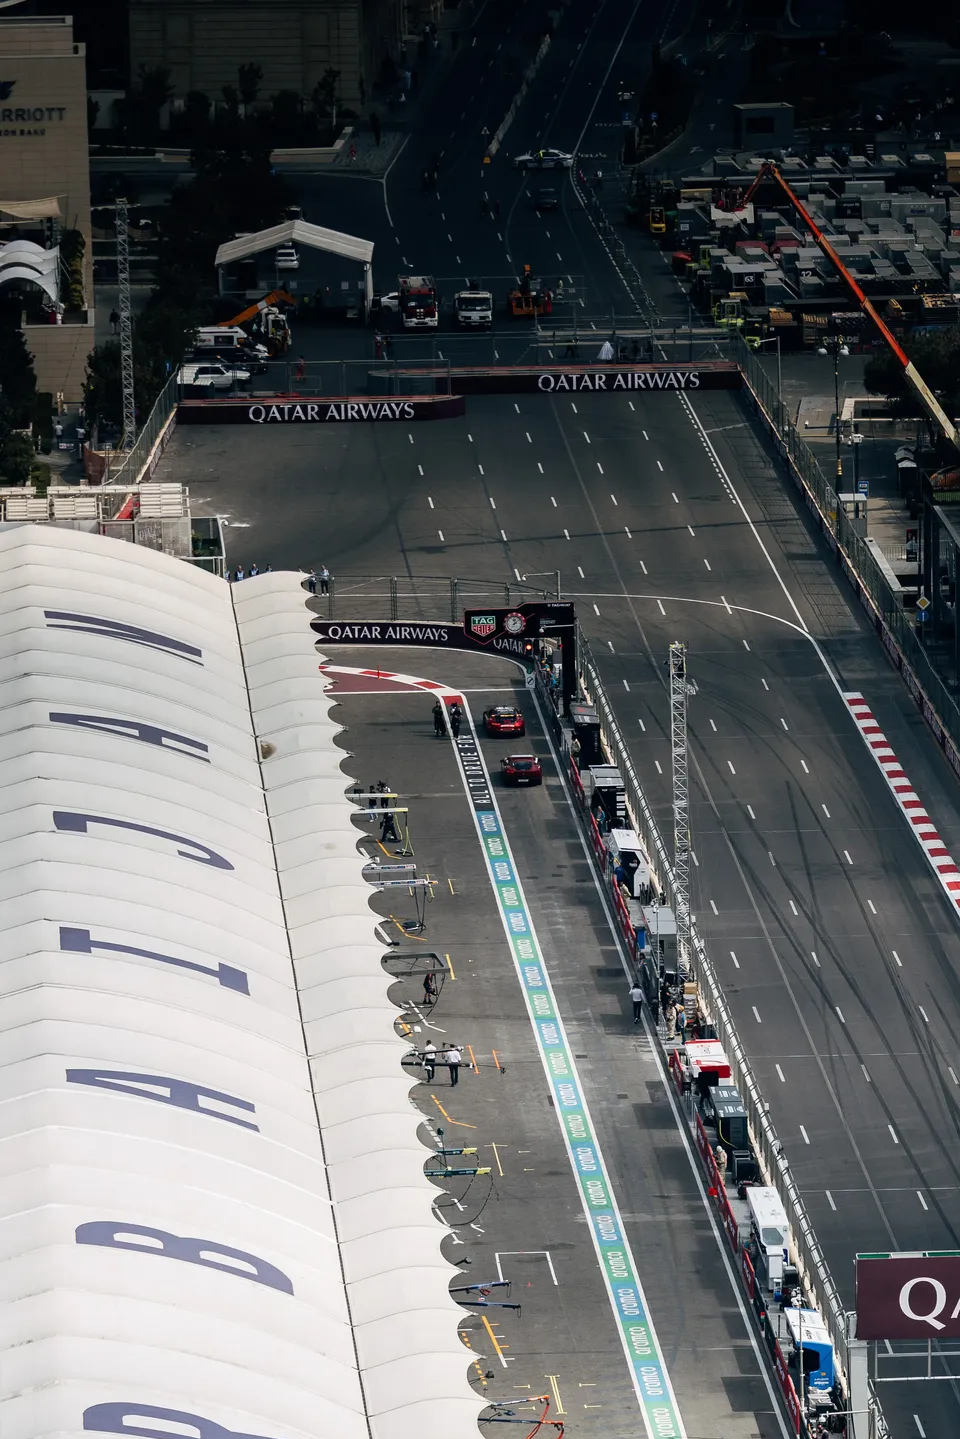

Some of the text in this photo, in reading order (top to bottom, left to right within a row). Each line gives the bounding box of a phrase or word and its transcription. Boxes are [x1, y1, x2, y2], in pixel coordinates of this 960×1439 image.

[0, 107, 66, 121] RRIOTT
[538, 372, 700, 392] QATAR AIRWAYS
[249, 402, 415, 423] QATAR AIRWAYS
[328, 625, 448, 642] QATAR AIRWAYS
[472, 625, 495, 635] HEUER
[493, 638, 523, 653] QATAR
[461, 752, 483, 774] DRIVE
[469, 779, 487, 787] TO
[474, 790, 491, 804] ALL
[481, 815, 497, 831] aramco
[488, 838, 503, 855] aramco
[495, 863, 511, 880] aramco
[502, 888, 518, 905] aramco
[509, 913, 526, 931] aramco
[517, 940, 534, 958] aramco
[525, 967, 542, 986] aramco
[533, 995, 550, 1014] aramco
[541, 1024, 559, 1044] aramco
[550, 1053, 568, 1074] aramco
[558, 1084, 577, 1105] aramco
[567, 1115, 586, 1137] aramco
[577, 1148, 596, 1170] aramco
[587, 1181, 607, 1205] aramco
[596, 1216, 617, 1240] aramco
[607, 1252, 628, 1277] aramco
[618, 1289, 639, 1315] aramco
[629, 1327, 651, 1354] aramco
[640, 1367, 663, 1395] aramco
[652, 1408, 675, 1437] aramco
